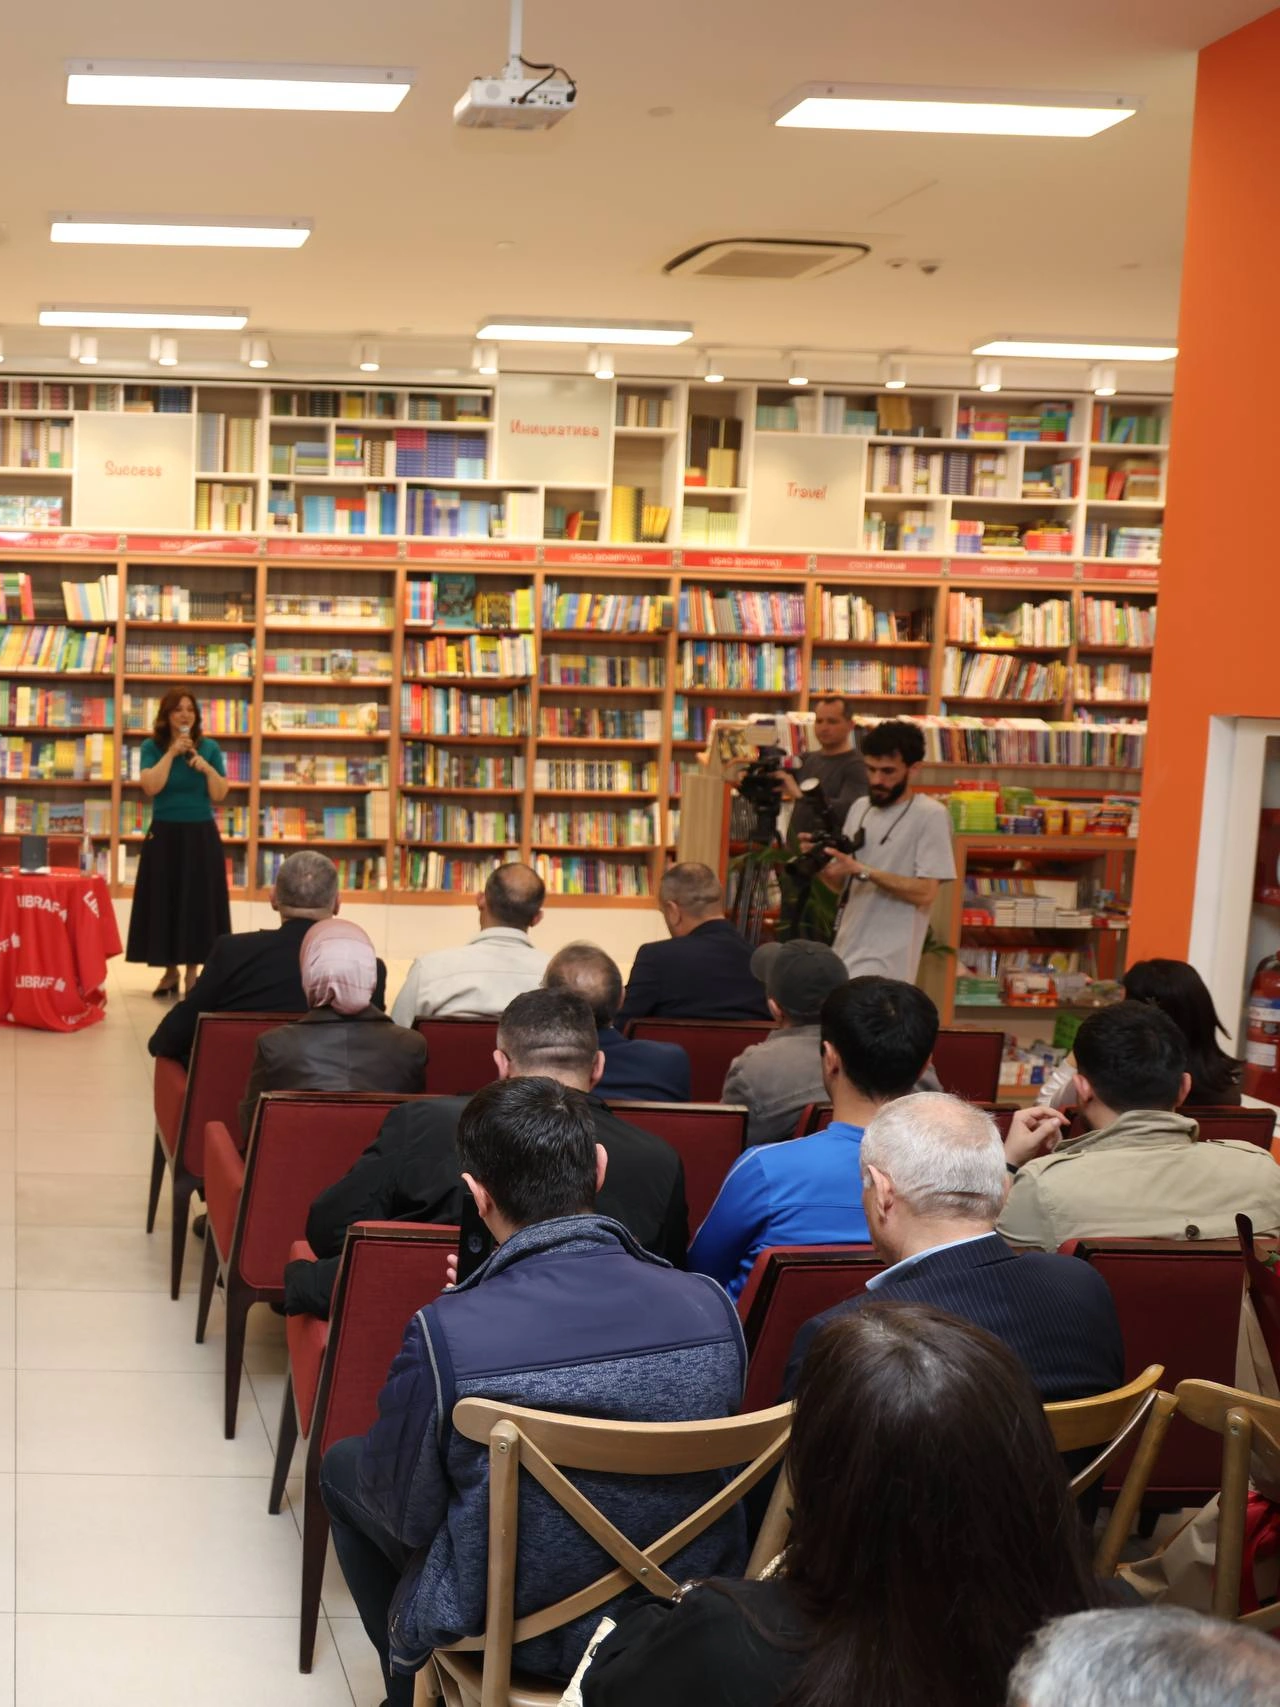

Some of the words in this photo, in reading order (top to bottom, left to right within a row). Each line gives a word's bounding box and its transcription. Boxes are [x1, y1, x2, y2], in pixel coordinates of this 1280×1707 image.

[510, 419, 600, 438] Инициатива
[104, 459, 162, 477] Success
[786, 481, 828, 500] Travel
[16, 894, 61, 913] LIBRAF
